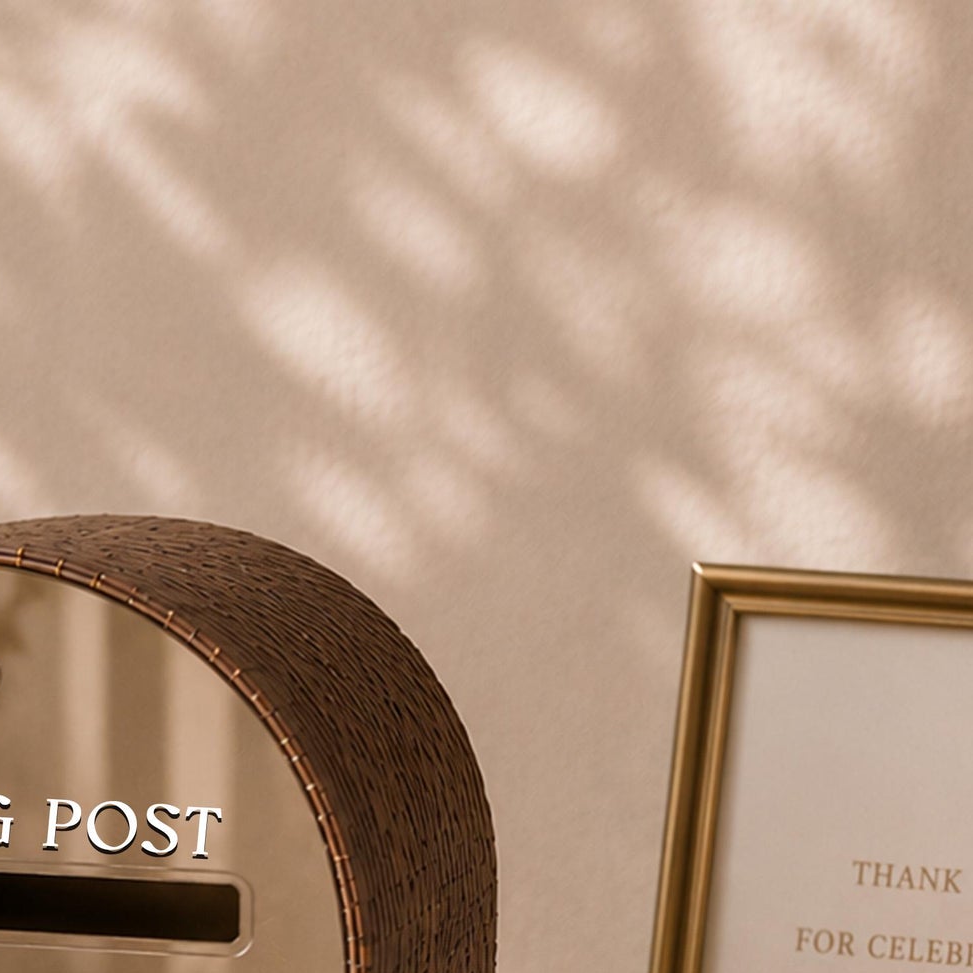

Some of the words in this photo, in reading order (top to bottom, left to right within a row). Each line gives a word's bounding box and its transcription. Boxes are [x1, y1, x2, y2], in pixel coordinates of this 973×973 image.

[42, 798, 223, 858] POST
[852, 860, 963, 894] THANK
[795, 927, 855, 957] FOR
